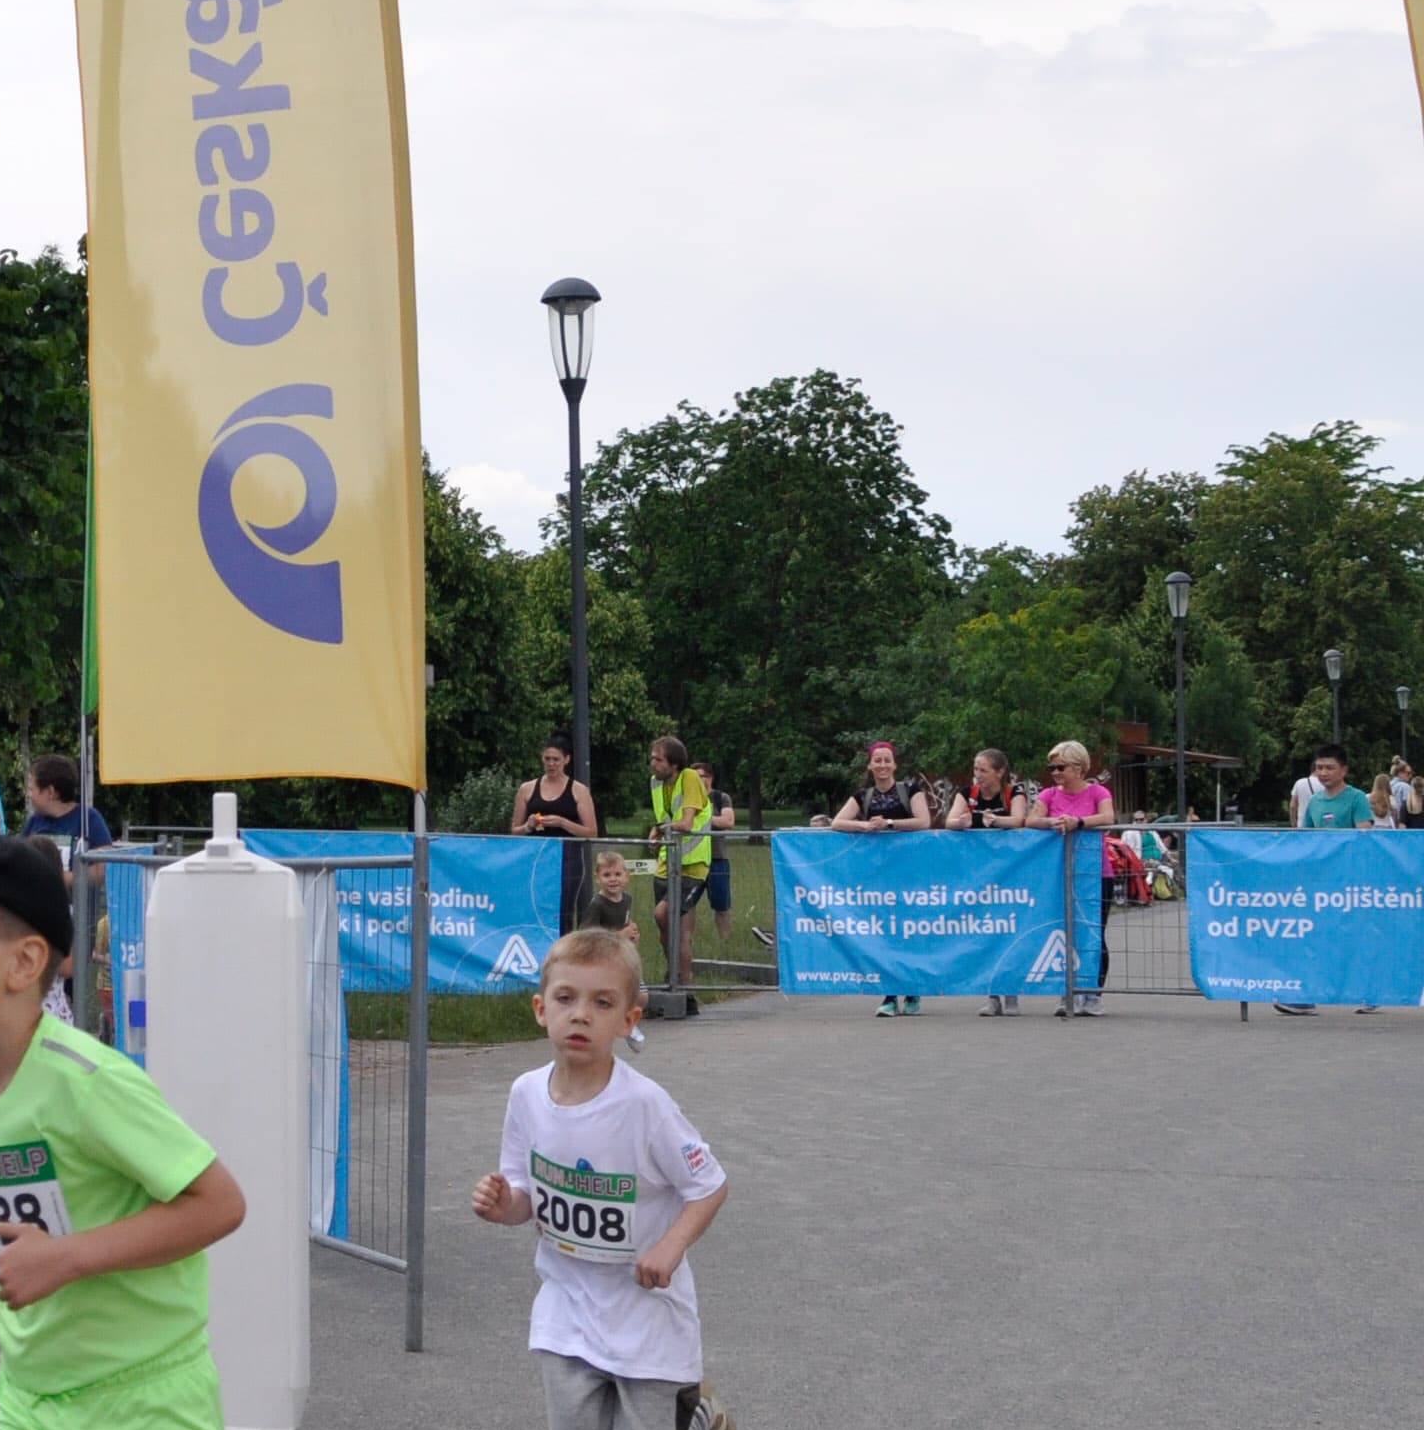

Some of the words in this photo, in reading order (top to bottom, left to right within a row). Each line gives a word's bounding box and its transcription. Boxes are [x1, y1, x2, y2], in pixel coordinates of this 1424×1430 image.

[367, 886, 412, 907] vaši
[426, 887, 495, 912] odinu,
[794, 884, 897, 909] Pojistíme
[902, 885, 947, 906] vaši
[953, 884, 1035, 908] rodinu,
[1208, 880, 1307, 908] Úrazové
[1314, 885, 1423, 912] pojištění
[367, 914, 476, 938] podkání
[795, 915, 884, 937] majetek
[890, 914, 897, 935] i
[903, 912, 1016, 939] podnikání
[1208, 915, 1239, 937] od
[1246, 918, 1314, 938] PVZP
[796, 971, 880, 984] www.pvzp.cz
[1207, 976, 1302, 991] www.pvzp.cz
[575, 1173, 633, 1198] HELP
[535, 1185, 626, 1243] 2008
